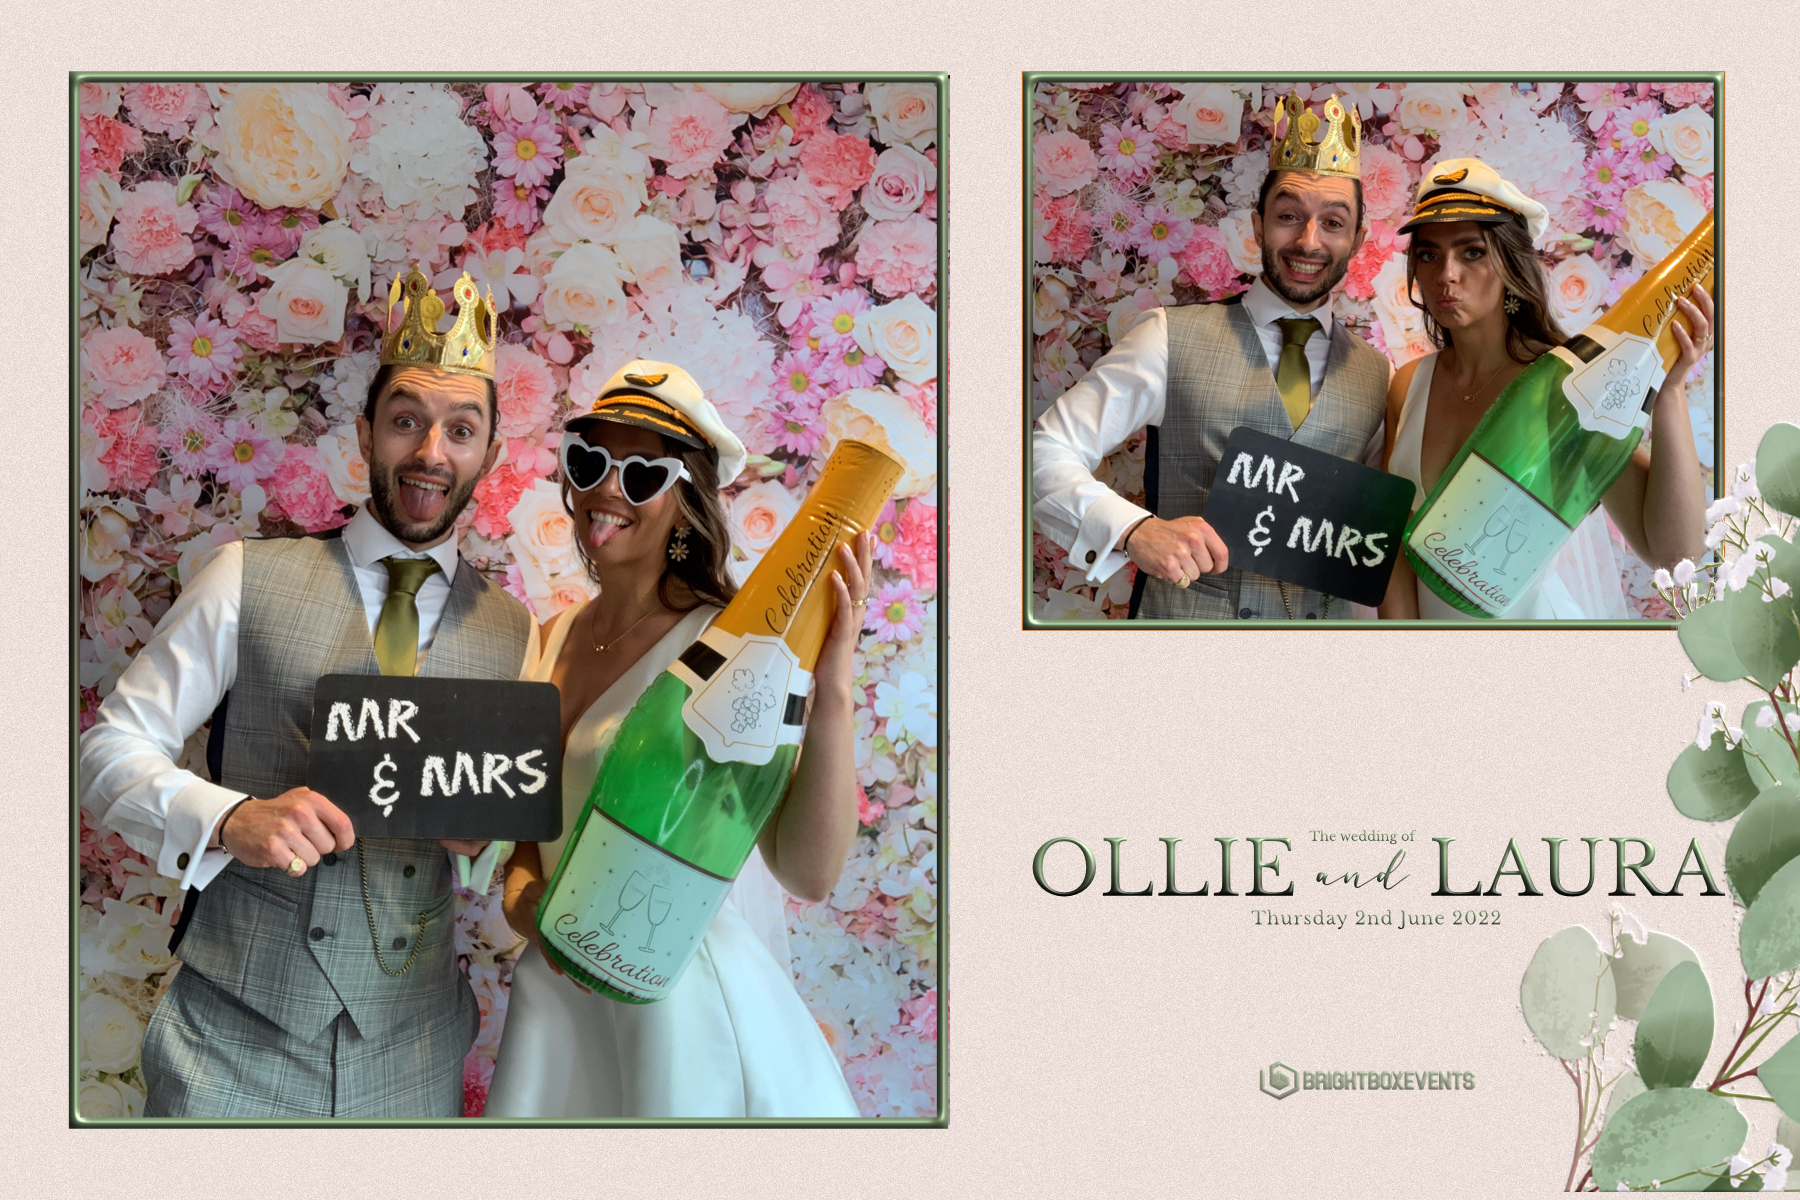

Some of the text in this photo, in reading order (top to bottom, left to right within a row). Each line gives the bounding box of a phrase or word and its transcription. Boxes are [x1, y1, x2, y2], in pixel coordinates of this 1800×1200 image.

[1642, 248, 1714, 338] Celebration
[1226, 451, 1305, 503] MR
[765, 509, 838, 634] Celebration
[1247, 505, 1388, 567] & MRS
[1423, 532, 1512, 607] Celebration
[325, 697, 421, 743] MR
[368, 749, 549, 817] & MRS
[554, 913, 671, 988] Celebration
